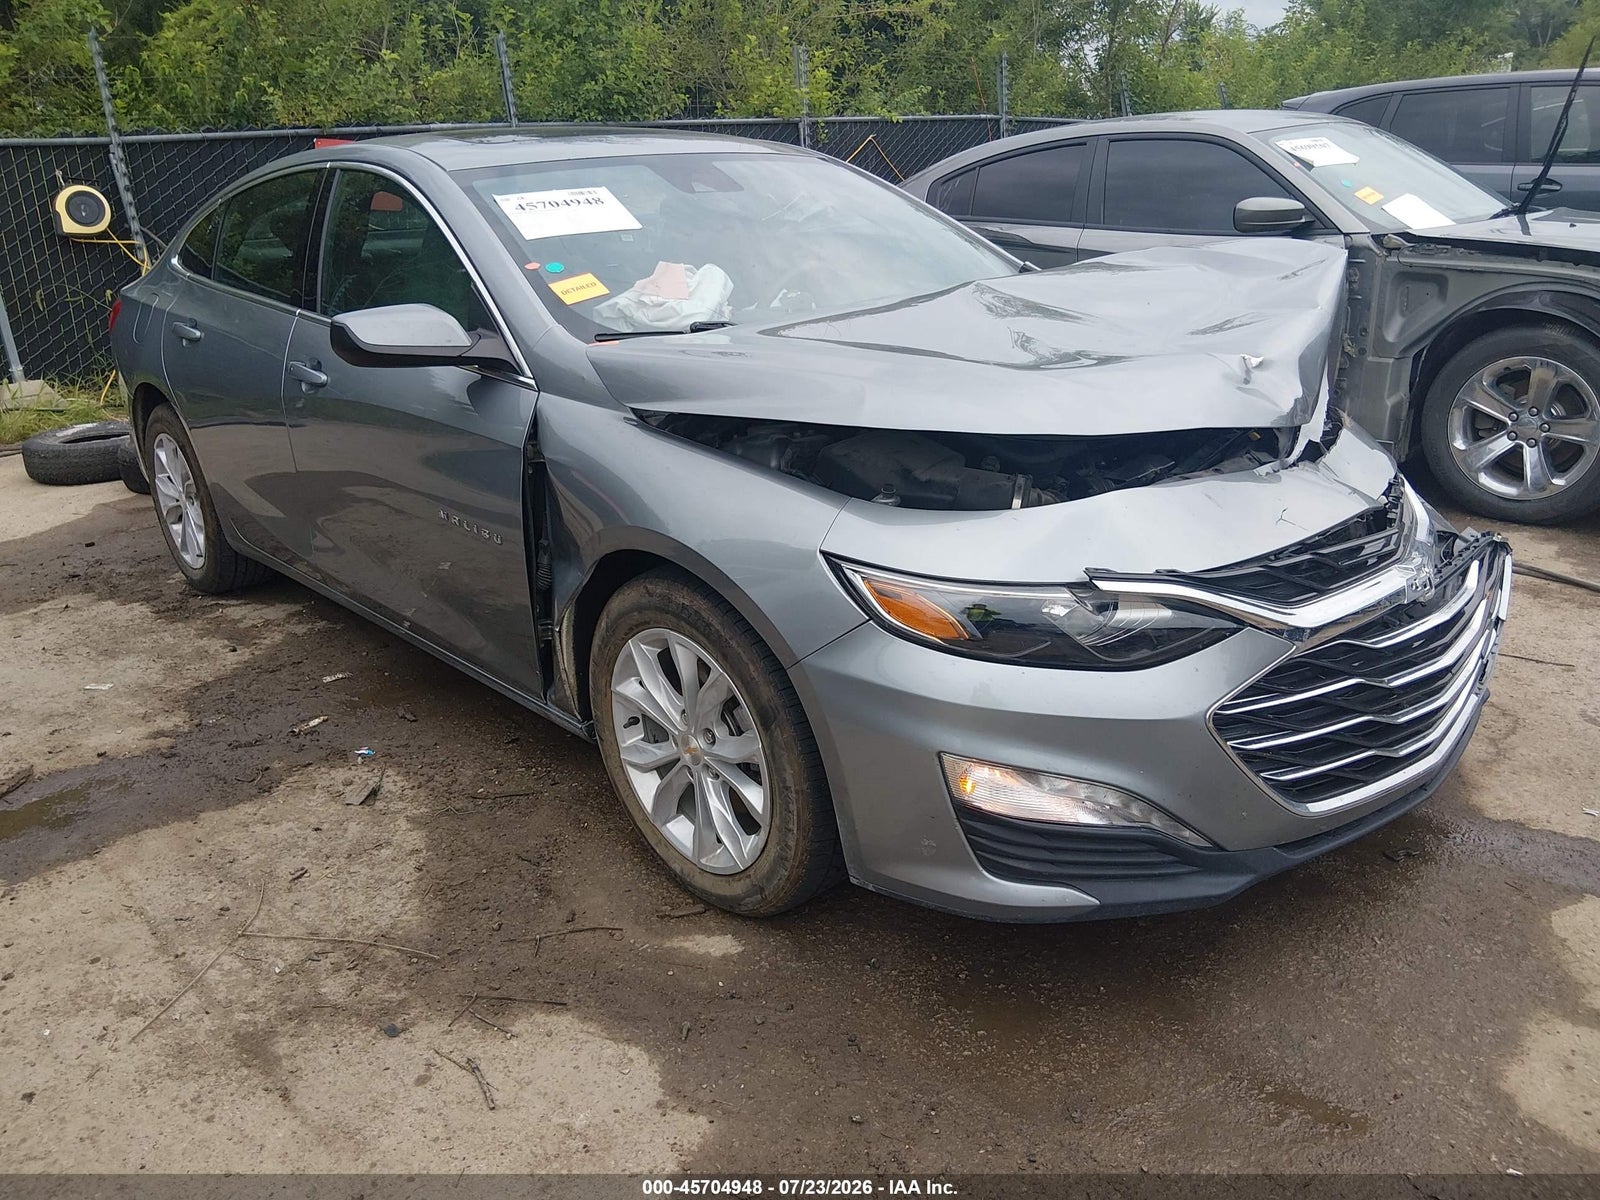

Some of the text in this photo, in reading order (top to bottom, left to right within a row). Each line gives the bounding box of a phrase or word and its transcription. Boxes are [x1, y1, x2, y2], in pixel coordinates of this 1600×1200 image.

[514, 196, 605, 211] 45704948
[560, 281, 598, 296] DETAILED
[438, 509, 503, 545] MALIBU
